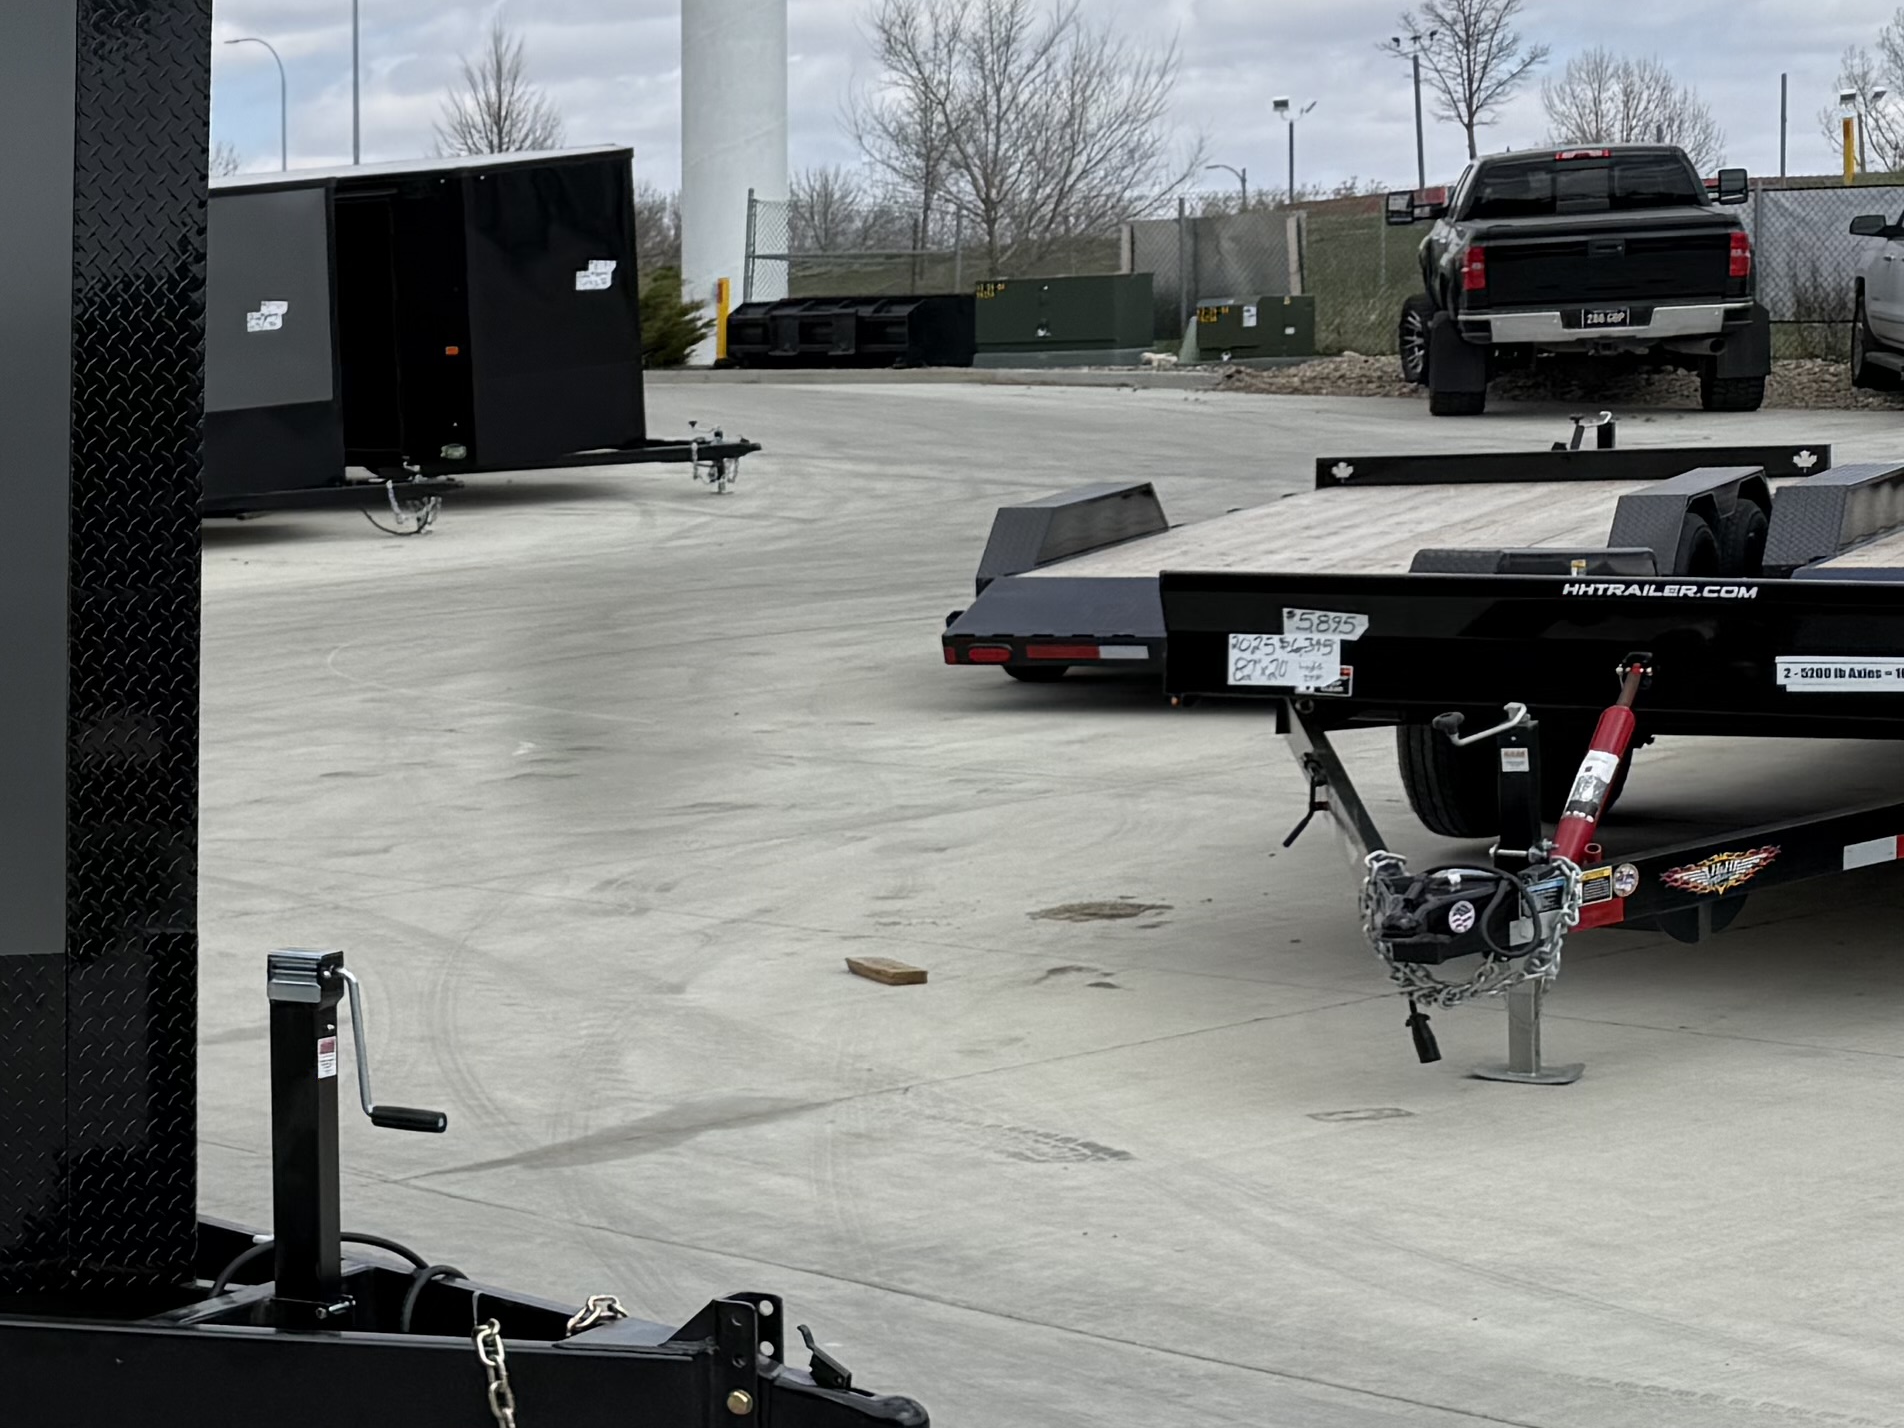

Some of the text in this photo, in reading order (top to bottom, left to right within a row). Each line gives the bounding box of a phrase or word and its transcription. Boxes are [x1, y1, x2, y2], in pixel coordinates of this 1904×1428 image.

[1562, 583, 1758, 599] HHTRAILER.COM
[1783, 667, 1791, 679] 2
[1800, 667, 1831, 679] 5200
[1834, 668, 1847, 679] lb
